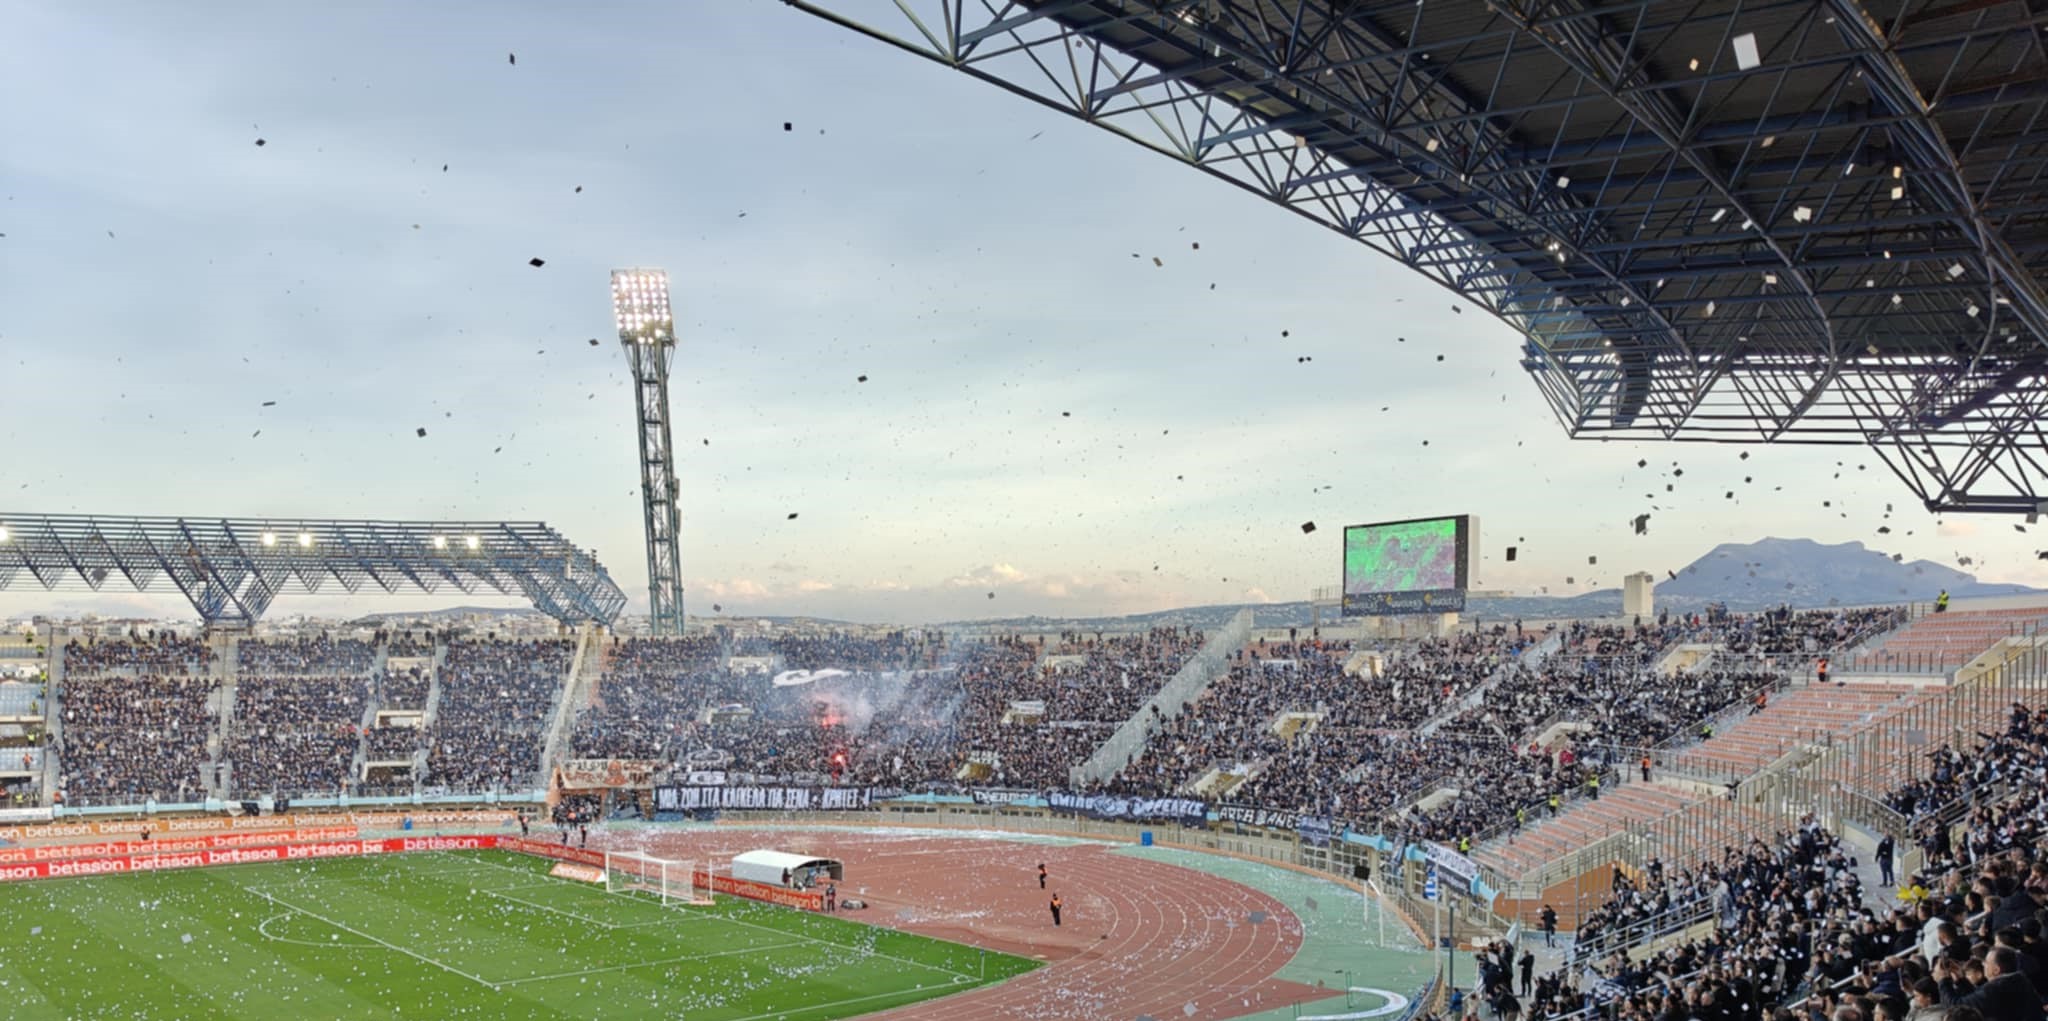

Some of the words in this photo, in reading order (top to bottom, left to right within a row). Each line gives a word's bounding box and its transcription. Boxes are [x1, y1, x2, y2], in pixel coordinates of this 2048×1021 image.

[702, 786, 720, 808] ΣΤΑ
[785, 787, 810, 809] ΣΕΝΑ
[26, 824, 92, 838] betsson
[99, 820, 158, 834] betsson
[169, 816, 225, 831] betsson
[232, 813, 289, 828] betsson
[34, 843, 119, 860] betsson
[127, 839, 207, 854] betsson
[213, 832, 289, 846] betsson
[49, 858, 125, 875] betsson
[130, 853, 203, 870] betsson
[209, 846, 278, 864] betsson
[287, 842, 358, 858] betsson
[403, 836, 479, 851] betsson
[735, 882, 771, 899] betsson
[773, 889, 810, 907] betsson
